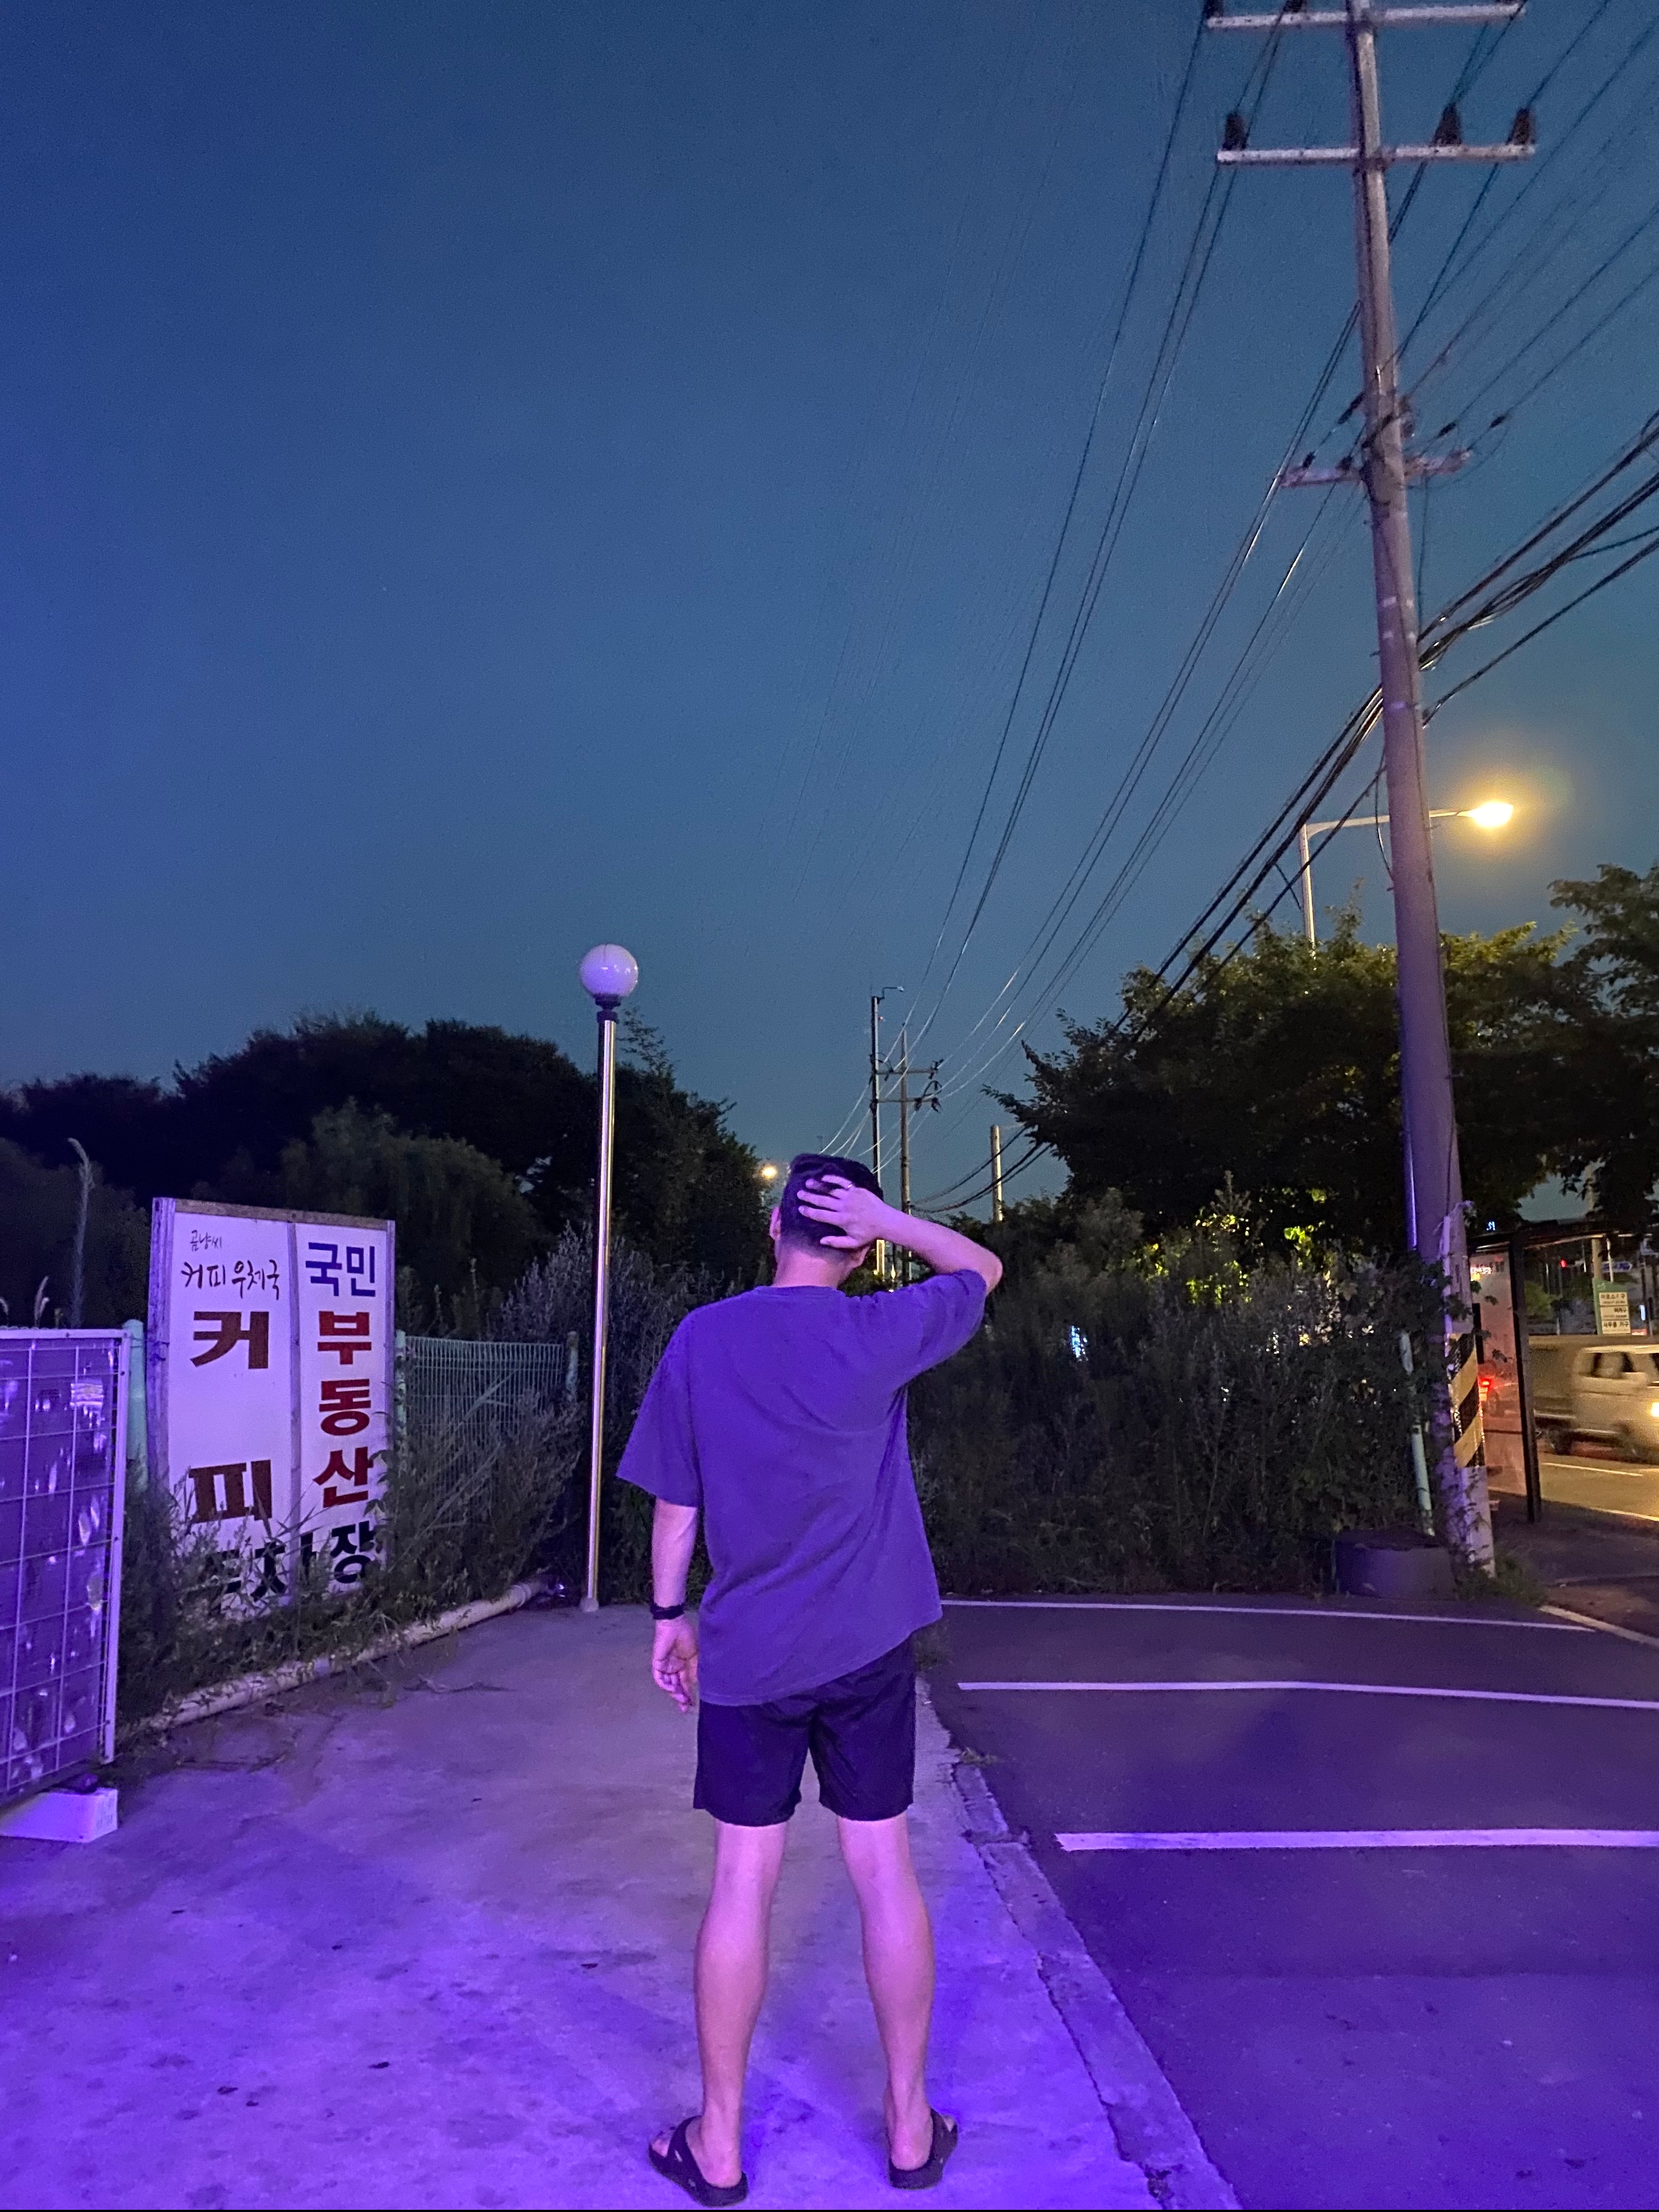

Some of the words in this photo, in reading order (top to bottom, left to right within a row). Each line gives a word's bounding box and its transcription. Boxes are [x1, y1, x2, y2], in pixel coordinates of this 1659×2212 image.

[181, 1261, 226, 1289] 커피
[232, 1259, 280, 1301] 우체국
[305, 1242, 376, 1297] 국민
[189, 1311, 273, 1523] 커피
[313, 1311, 374, 1508] 부동산
